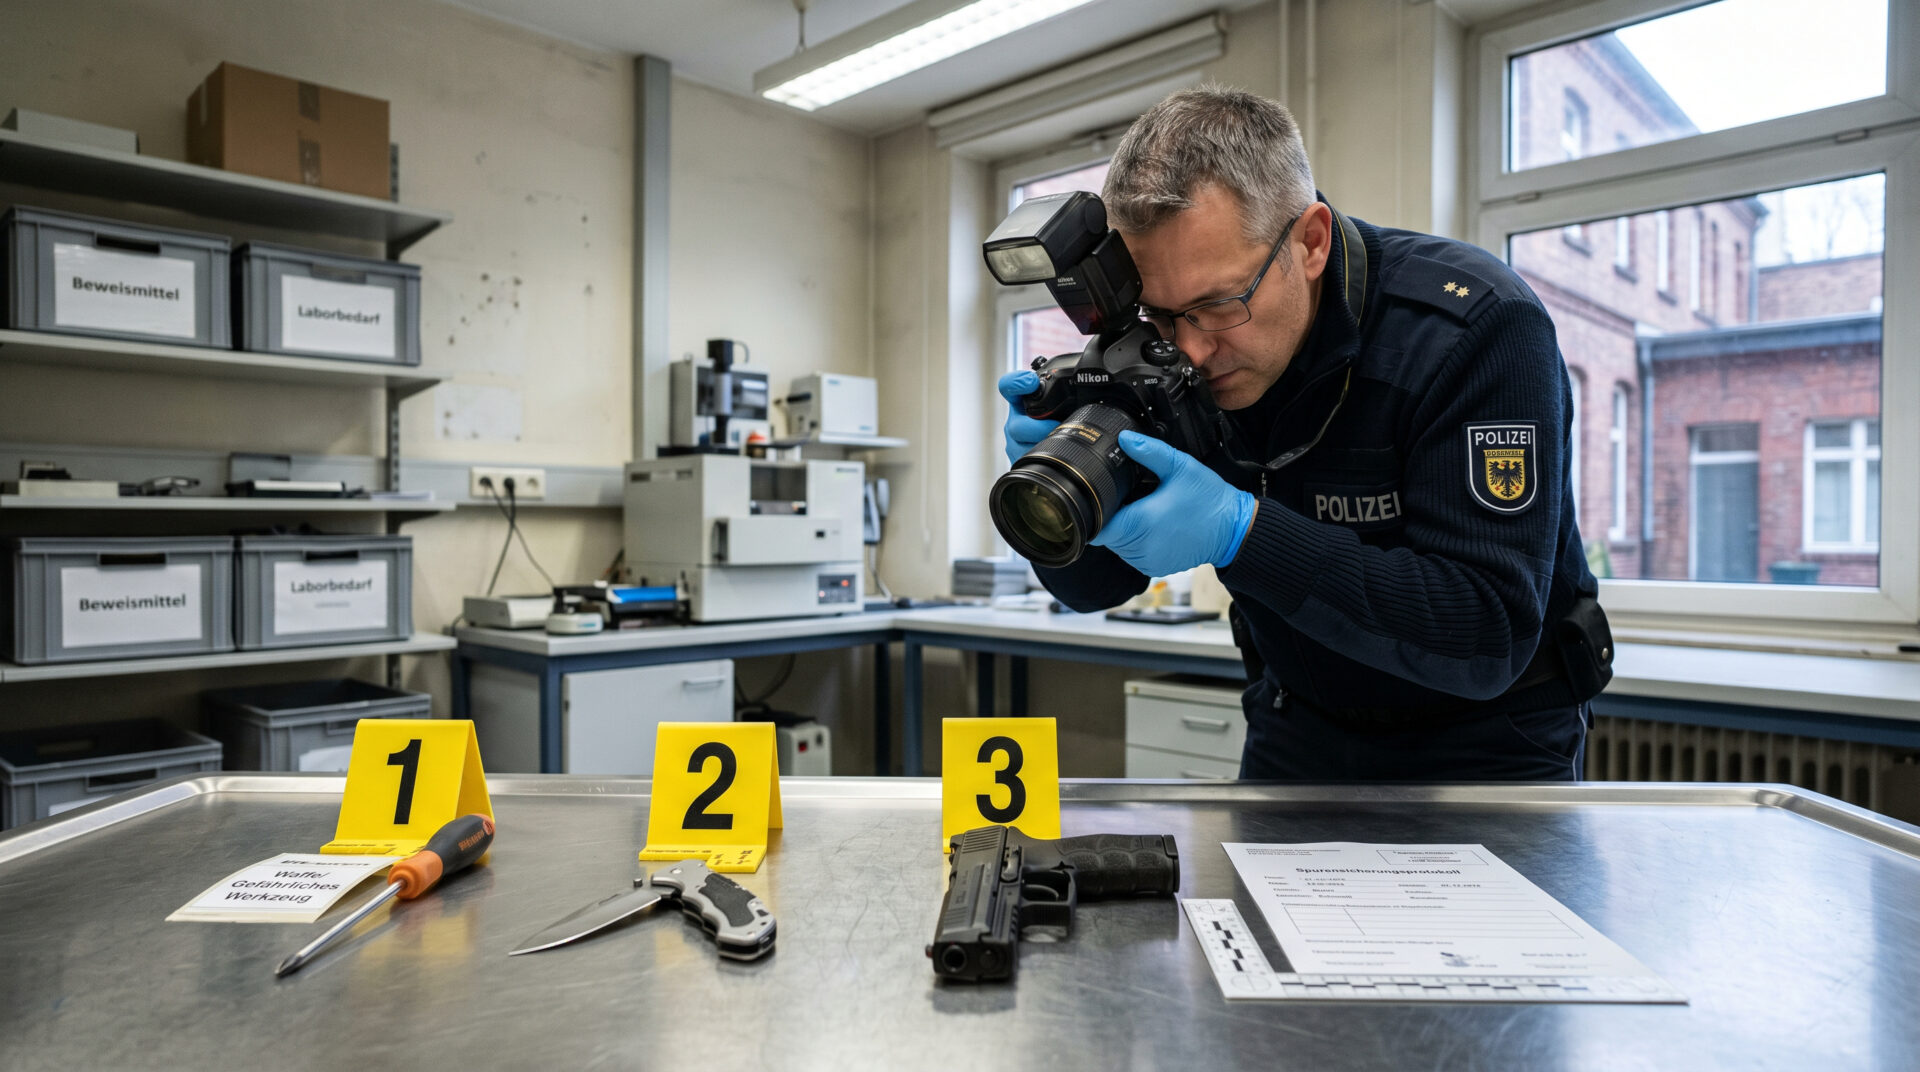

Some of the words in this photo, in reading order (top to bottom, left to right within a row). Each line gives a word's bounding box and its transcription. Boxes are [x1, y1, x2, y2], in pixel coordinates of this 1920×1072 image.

[72, 275, 180, 302] Beweismittel
[297, 305, 381, 326] Laborbedarf
[1077, 373, 1109, 383] Nikon
[1475, 430, 1531, 446] POLIZEI
[1314, 491, 1402, 523] POLIZEI
[290, 578, 373, 594] Laborbedarf
[78, 593, 187, 612] Beweismittel
[386, 738, 423, 825] 1
[681, 741, 737, 830] 2
[975, 735, 1027, 824] 3
[273, 870, 331, 880] Waffe/
[230, 880, 341, 891] Gefährliches
[223, 891, 313, 904] Werkzeug
